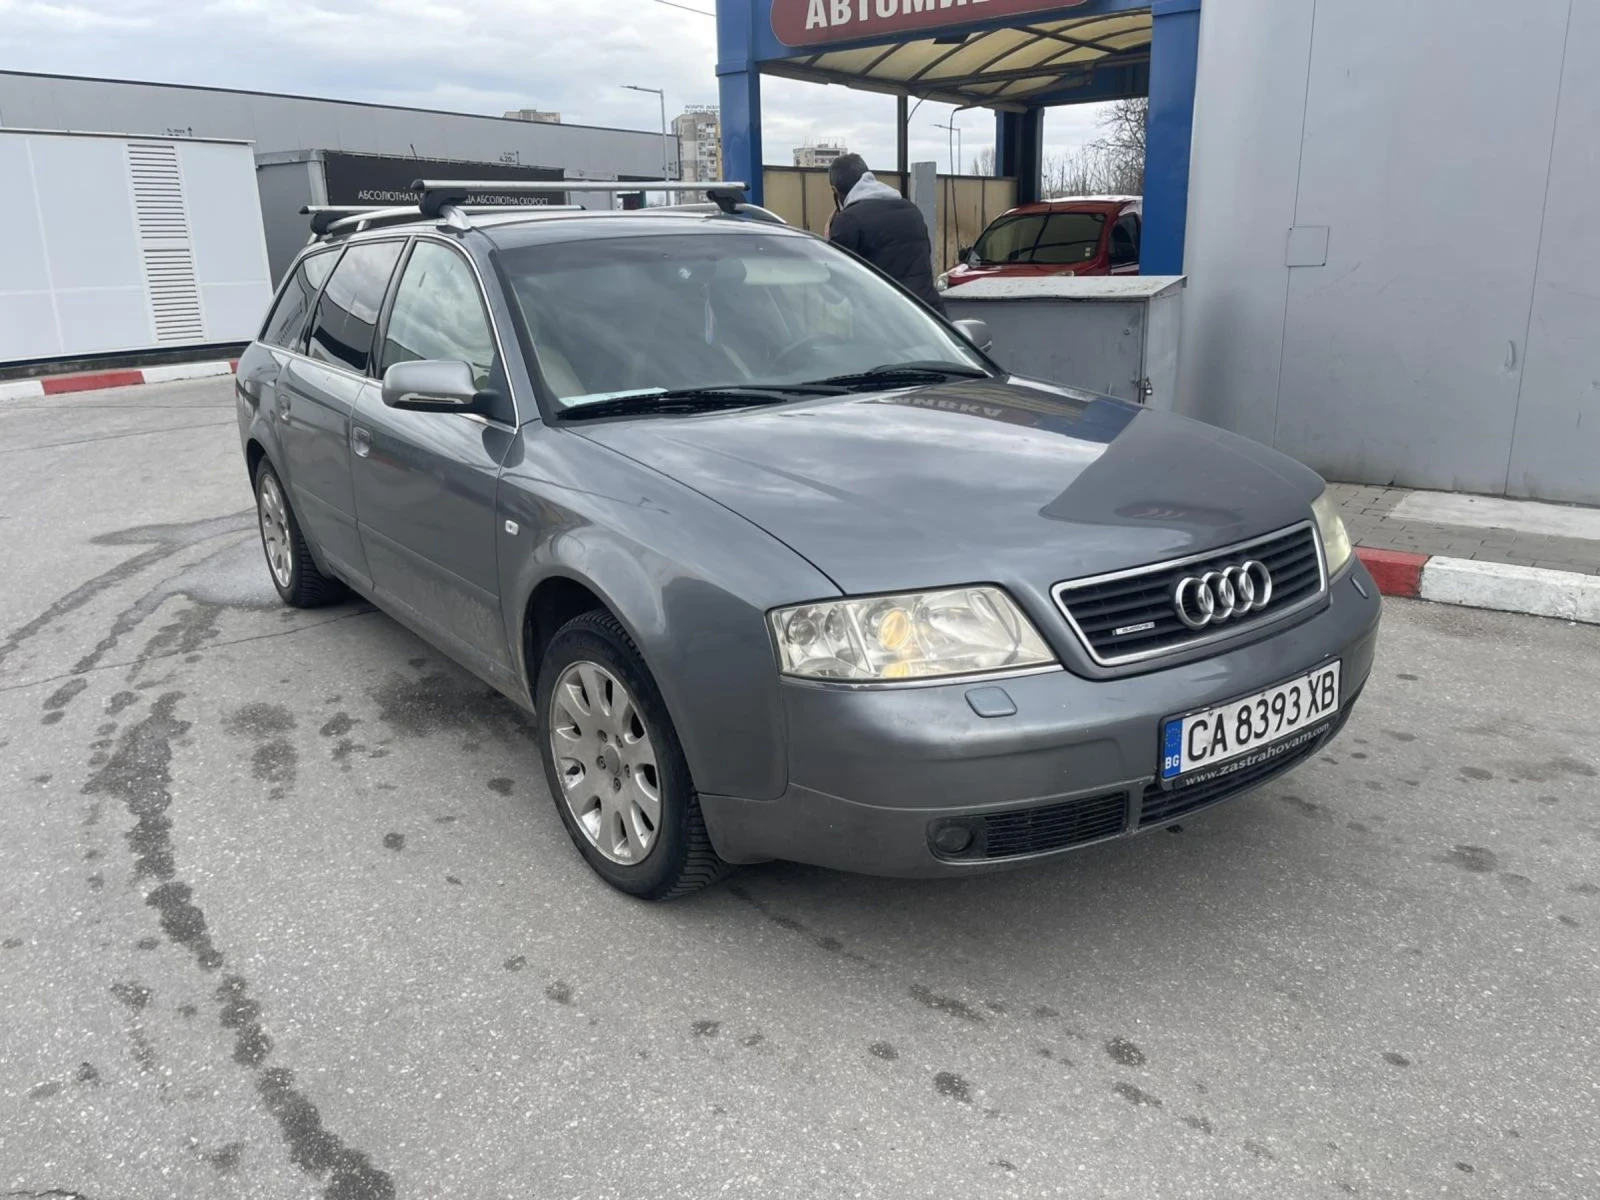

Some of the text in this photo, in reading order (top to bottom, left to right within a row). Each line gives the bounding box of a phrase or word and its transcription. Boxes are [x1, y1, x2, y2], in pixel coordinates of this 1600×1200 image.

[806, 0, 990, 31] АВТО
[358, 190, 418, 201] АБСОЛЮТНАТА
[476, 195, 518, 205] АБСОЛЮТНА
[519, 197, 549, 206] СКОРОСТ
[1187, 670, 1335, 762] CA 8393 XB
[1165, 754, 1180, 770] BG
[1185, 722, 1330, 786] www.zastrahovam.com
